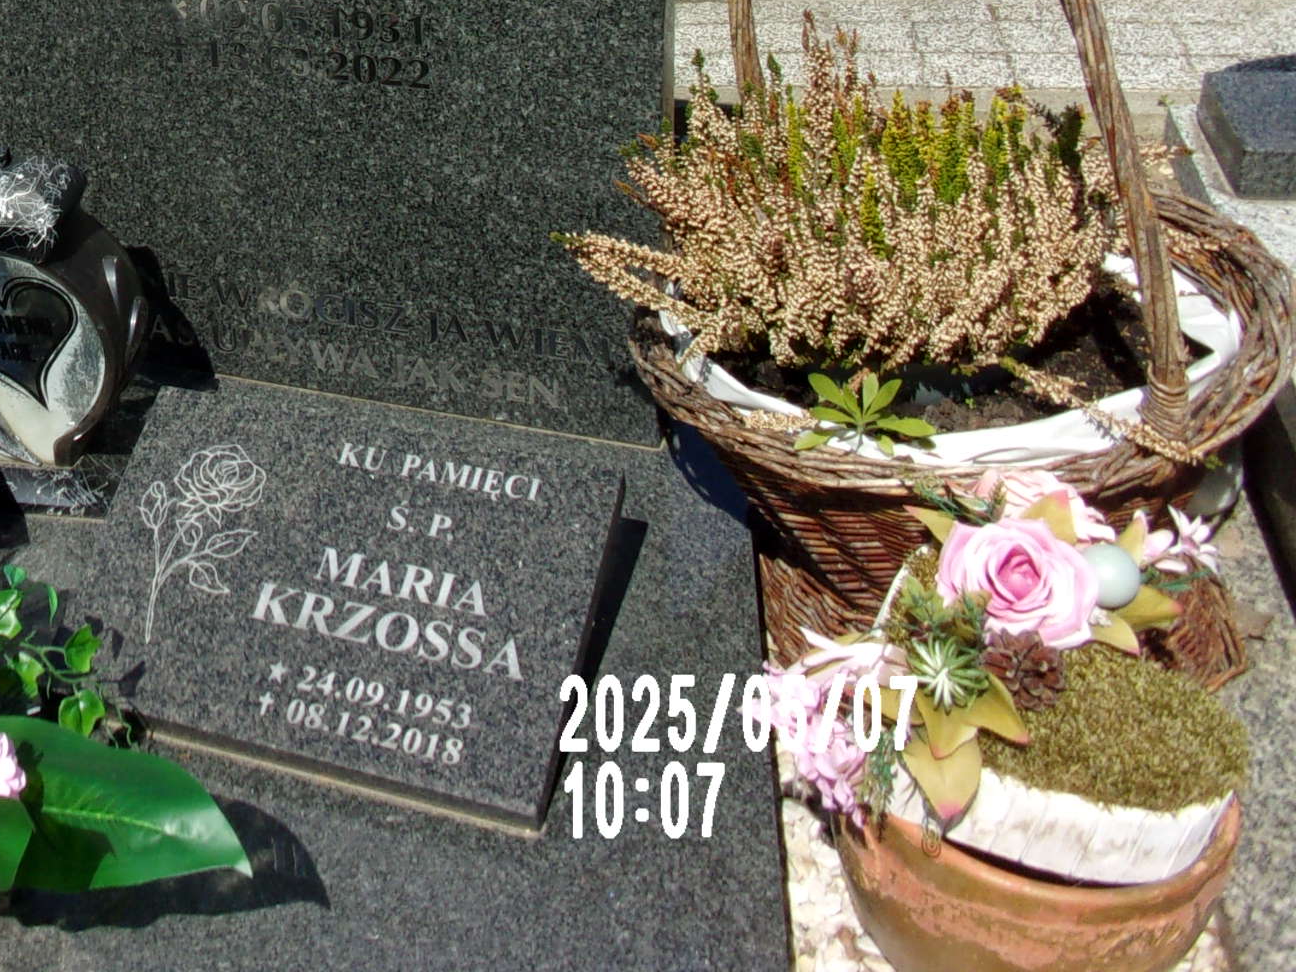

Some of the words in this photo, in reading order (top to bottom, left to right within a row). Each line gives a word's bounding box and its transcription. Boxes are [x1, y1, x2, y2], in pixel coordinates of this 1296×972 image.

[338, 442, 387, 471] KU
[401, 454, 543, 502] PAMIĘCI
[387, 501, 414, 532] Ś.
[429, 513, 454, 541] P.
[315, 547, 487, 617] MARIA
[252, 582, 523, 681] KRZOSSA
[297, 665, 473, 729] 24.09.1953
[287, 698, 464, 765] 08.12.2018
